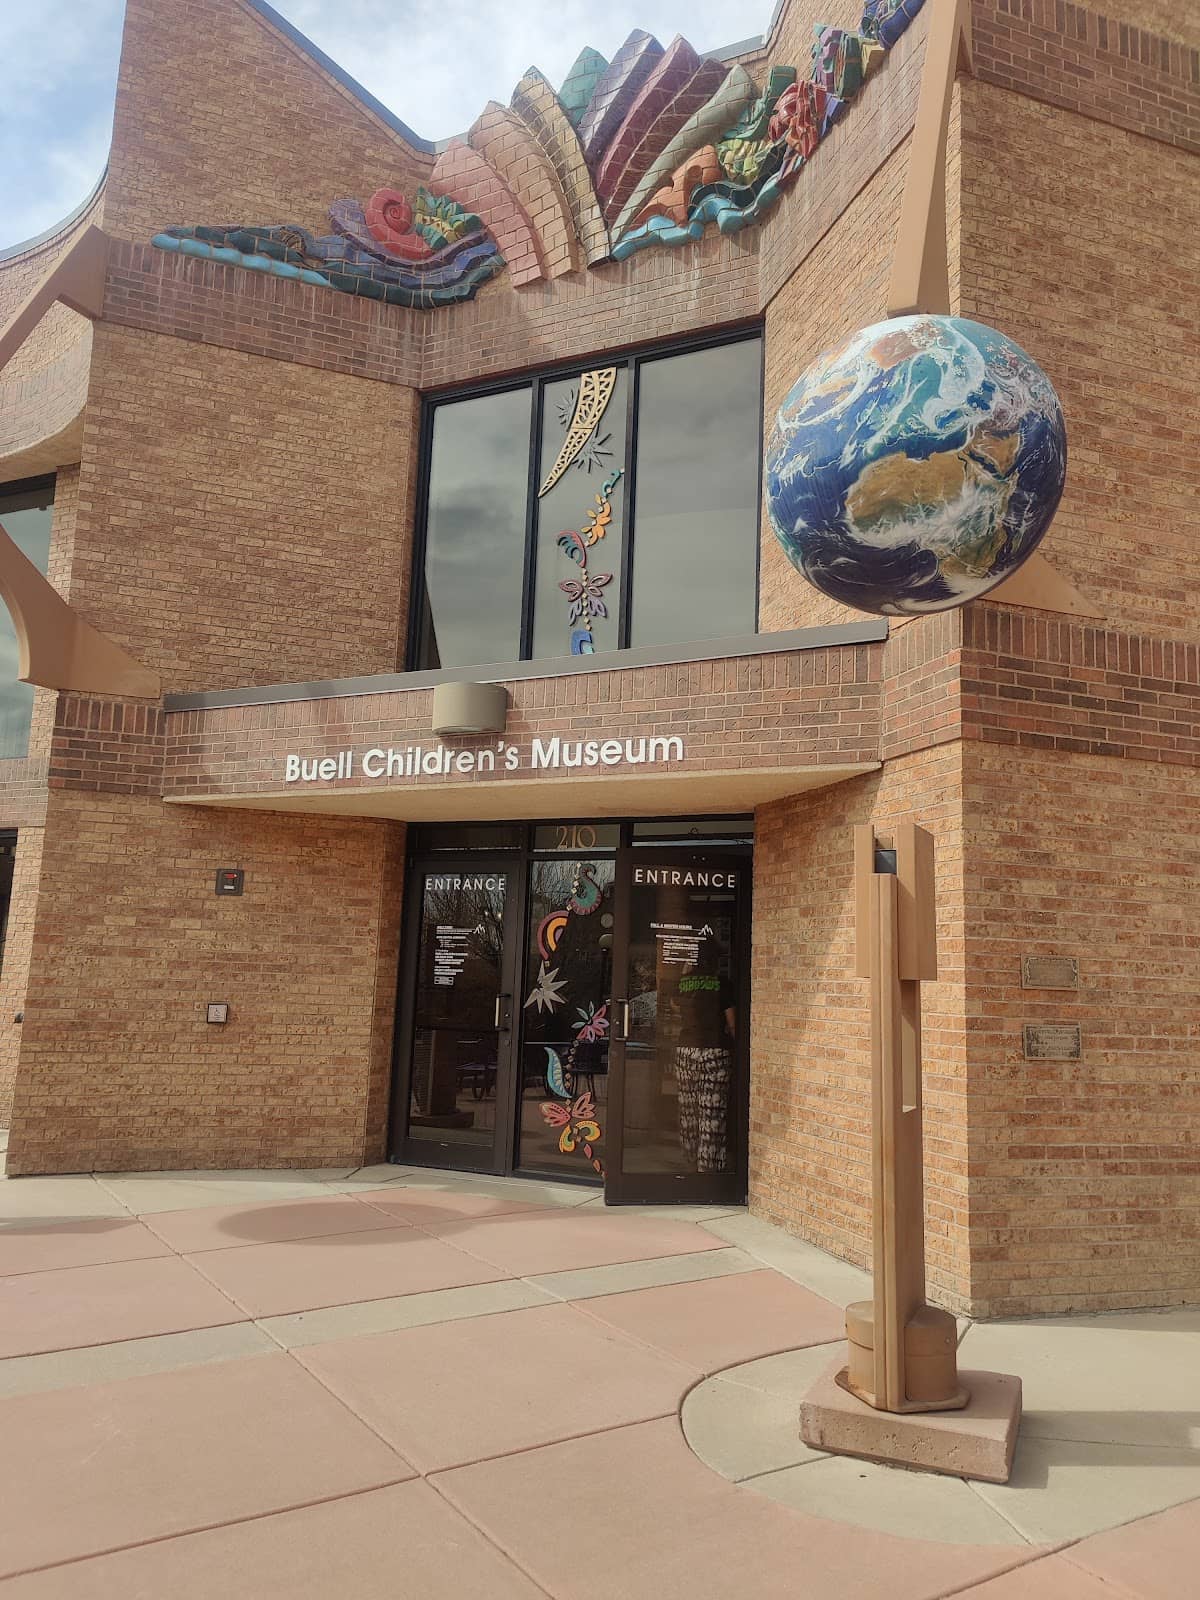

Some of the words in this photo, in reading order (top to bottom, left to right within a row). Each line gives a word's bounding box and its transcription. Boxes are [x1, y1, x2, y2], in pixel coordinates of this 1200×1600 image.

[285, 754, 353, 783] Buell
[362, 741, 519, 778] Children's
[531, 735, 684, 769] Museum
[556, 825, 596, 849] 210
[425, 878, 505, 891] ENTRANCE
[634, 868, 736, 889] ENTRANCE
